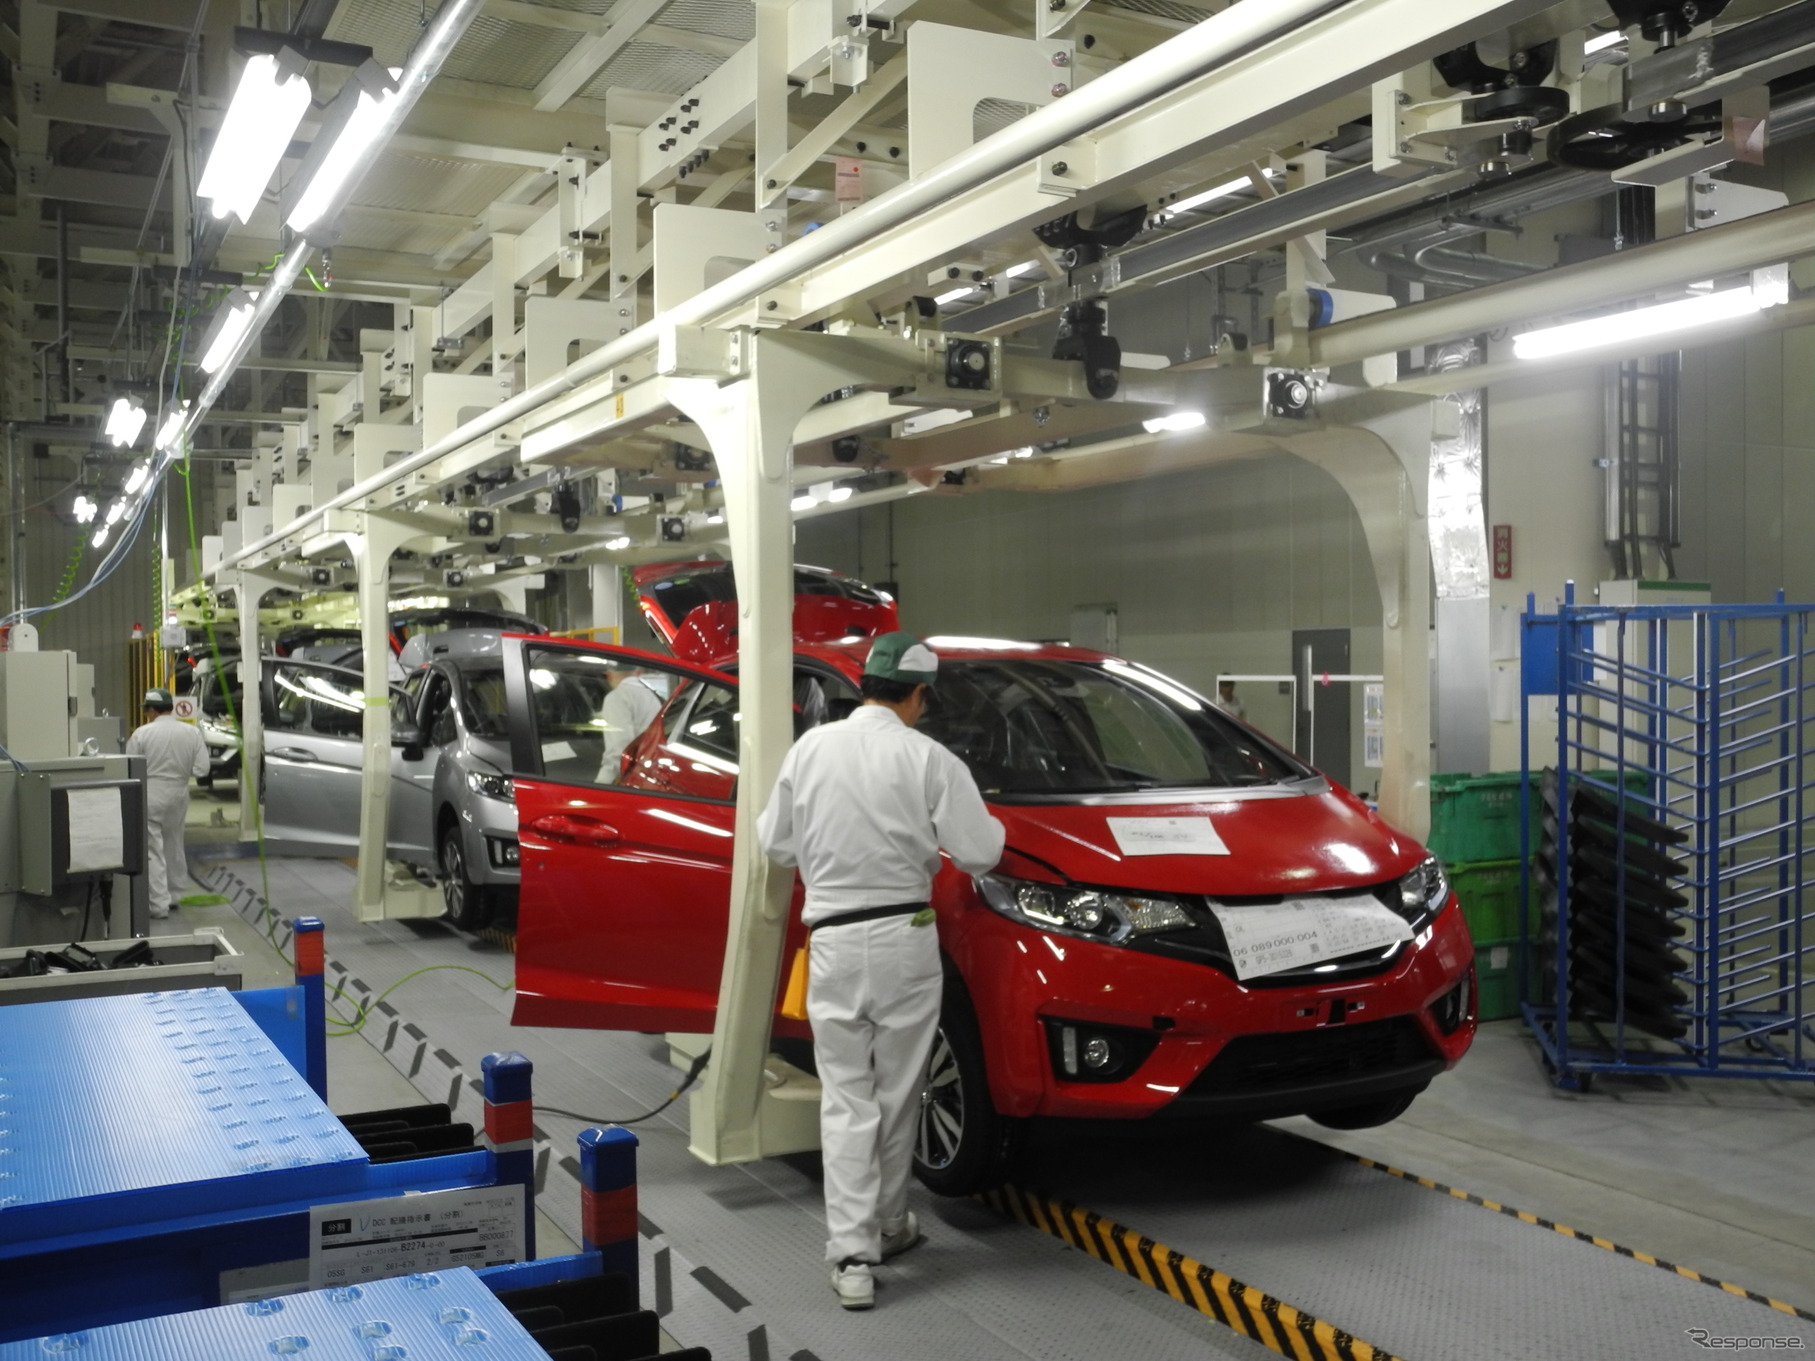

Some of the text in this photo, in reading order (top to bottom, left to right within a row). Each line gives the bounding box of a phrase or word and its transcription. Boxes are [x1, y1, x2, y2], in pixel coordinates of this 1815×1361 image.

[1233, 947, 1248, 957] 06
[1251, 941, 1272, 952] 089
[1273, 936, 1295, 947] 000
[1297, 931, 1318, 942] 004
